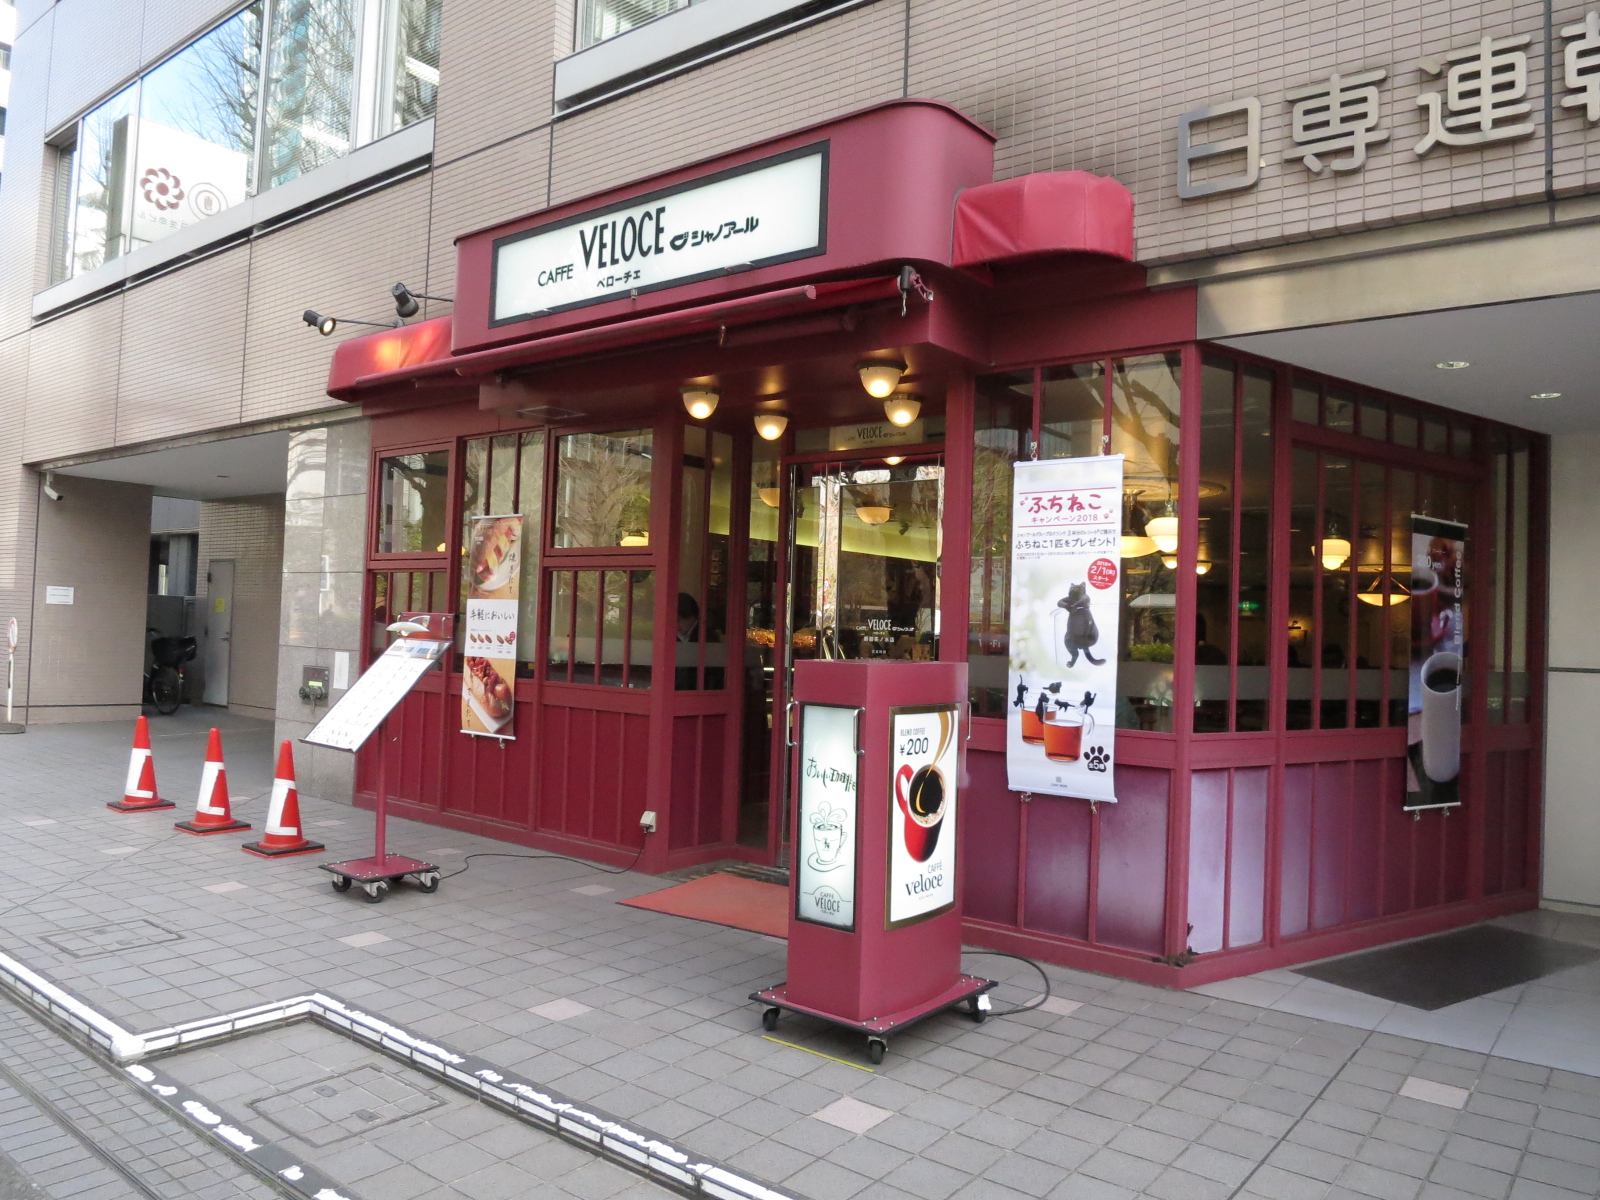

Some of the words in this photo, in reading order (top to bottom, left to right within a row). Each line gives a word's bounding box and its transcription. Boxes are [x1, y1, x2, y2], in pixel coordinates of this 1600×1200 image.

[691, 216, 759, 247] シャノアール
[537, 263, 574, 287] CAFFE
[579, 206, 666, 271] VELOCE
[857, 426, 882, 439] VELOCE
[1028, 493, 1102, 514] ふちねこ
[1031, 513, 1098, 524] キャンペーン2018
[1454, 551, 1462, 598] Coffee
[470, 608, 515, 620] 手軽においしい
[868, 619, 891, 631] VELOCE
[899, 737, 929, 756] ¥200
[905, 873, 943, 896] veloce
[815, 897, 840, 912] VELOCE
